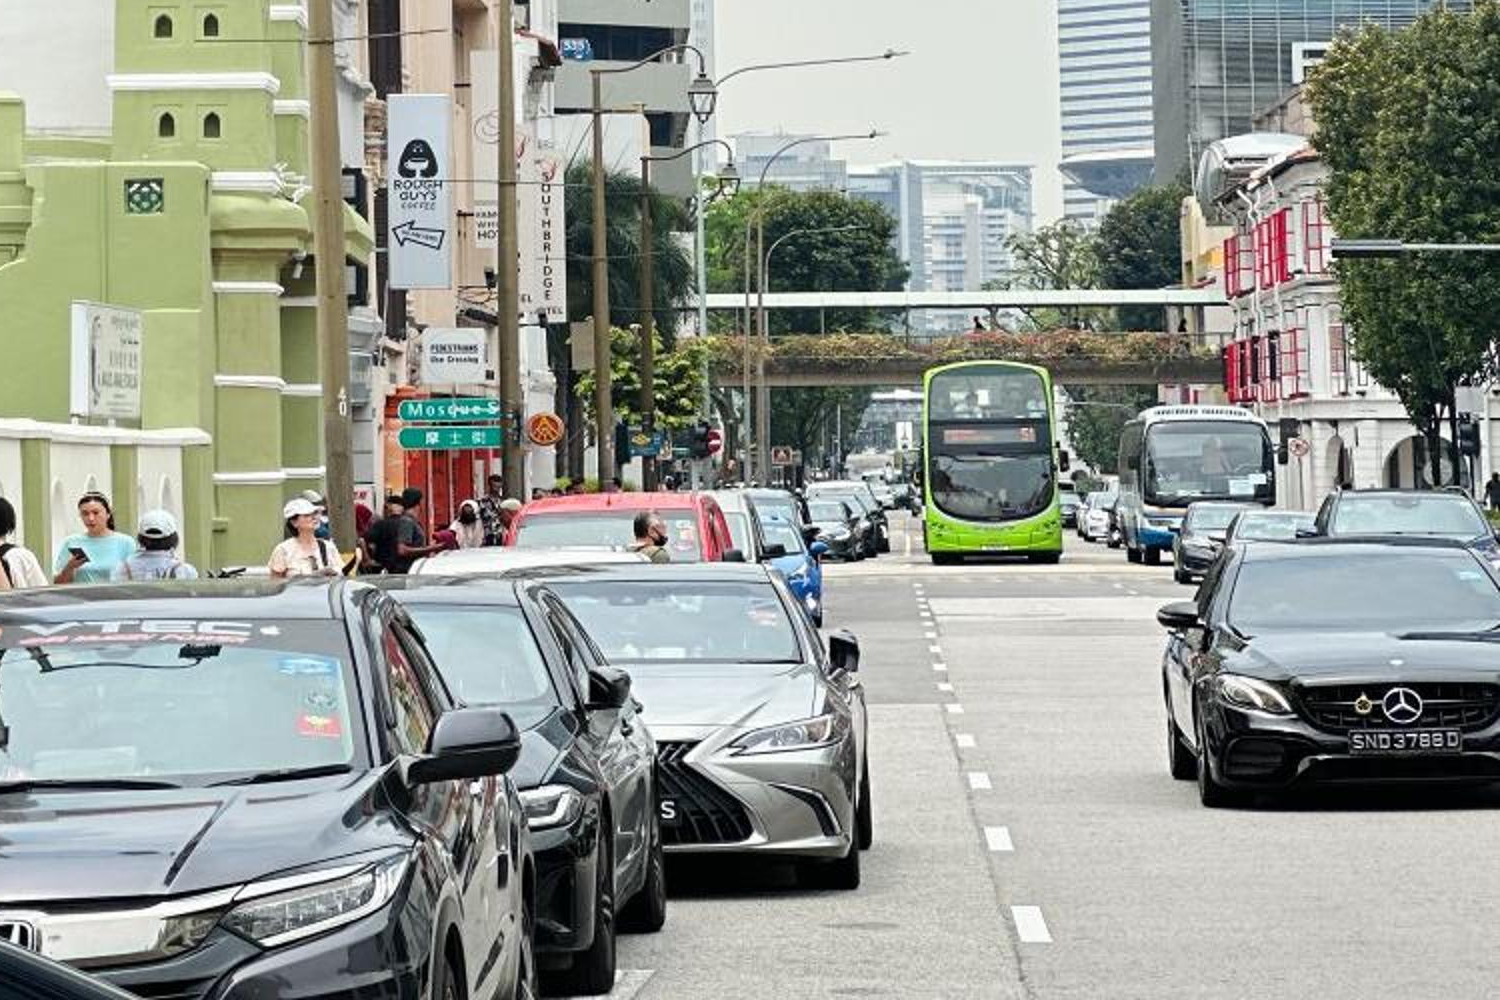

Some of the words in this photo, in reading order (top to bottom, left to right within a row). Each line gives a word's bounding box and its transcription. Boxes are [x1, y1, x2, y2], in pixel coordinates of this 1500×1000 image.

[393, 180, 442, 190] ROUGH
[399, 191, 436, 201] GUYS
[407, 402, 481, 418] Mosque
[487, 401, 500, 415] S
[19, 620, 253, 637] VTEC
